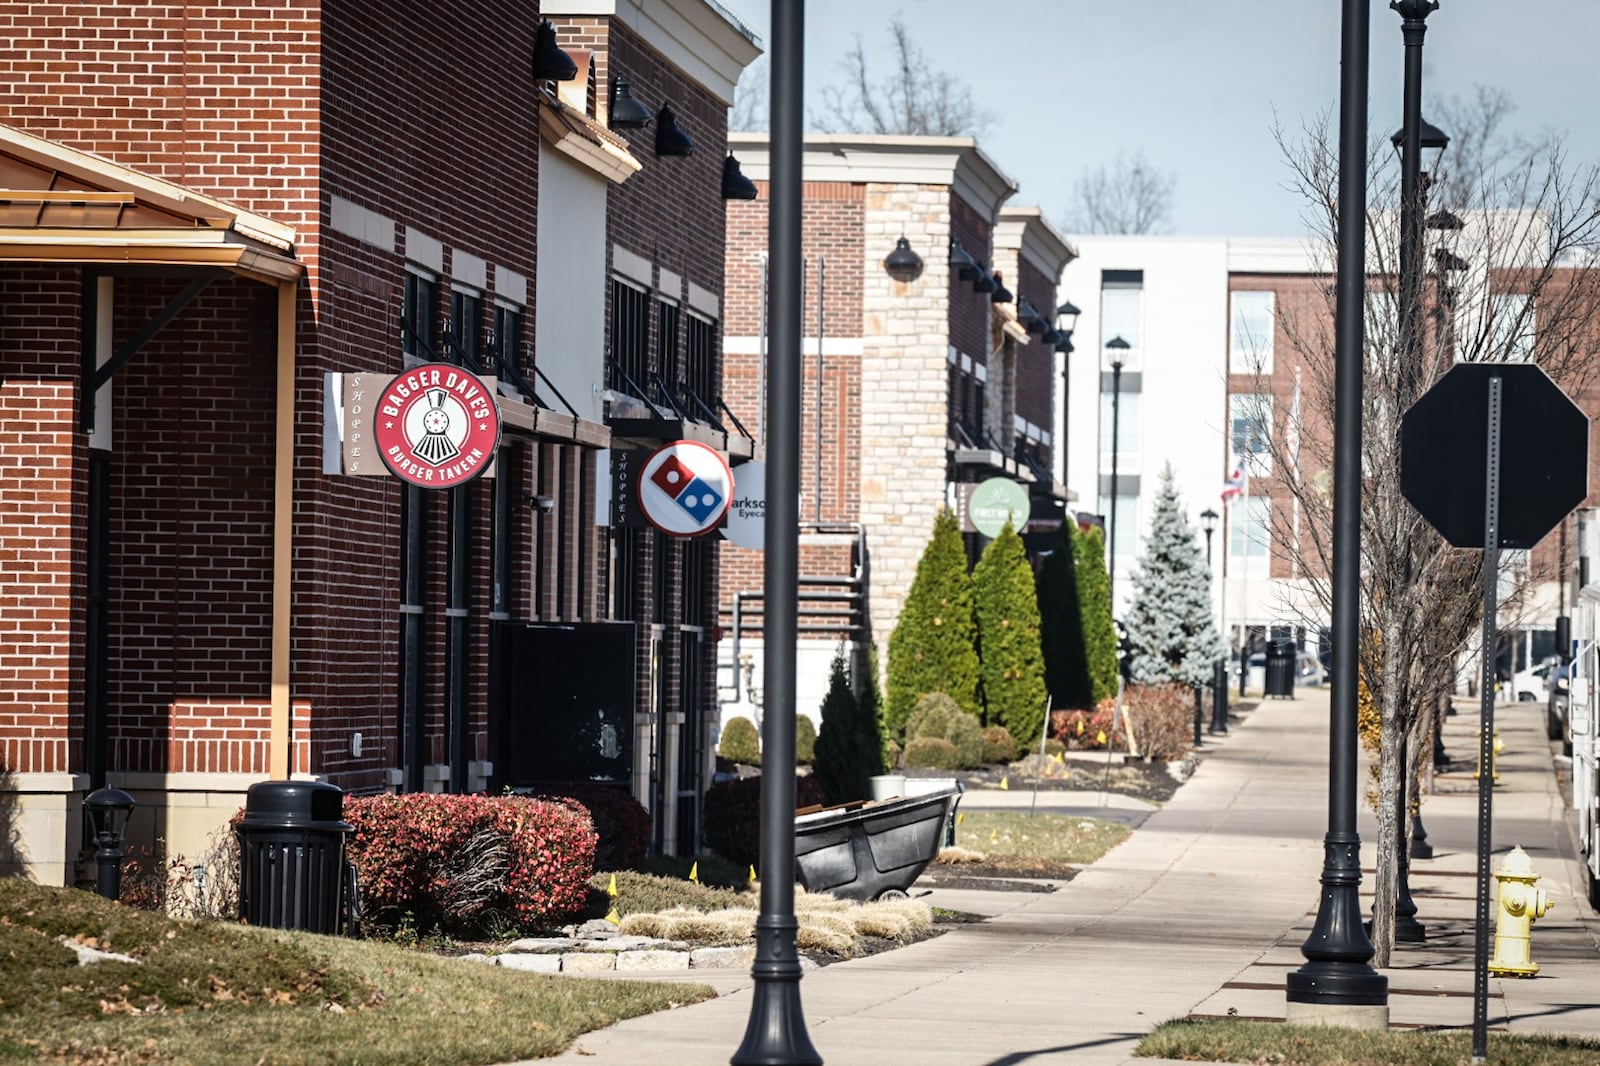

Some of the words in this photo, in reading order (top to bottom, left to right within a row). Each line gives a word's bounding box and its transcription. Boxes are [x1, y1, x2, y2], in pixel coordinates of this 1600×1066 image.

[382, 370, 440, 417] BAGGER
[446, 372, 490, 419] DAVE'S
[350, 377, 364, 472] SHOPPES
[388, 445, 433, 481] BURGER
[439, 447, 484, 481] TAVERN
[618, 452, 628, 523] SHOPPES
[731, 496, 766, 509] arkso
[739, 509, 766, 520] Eyeca
